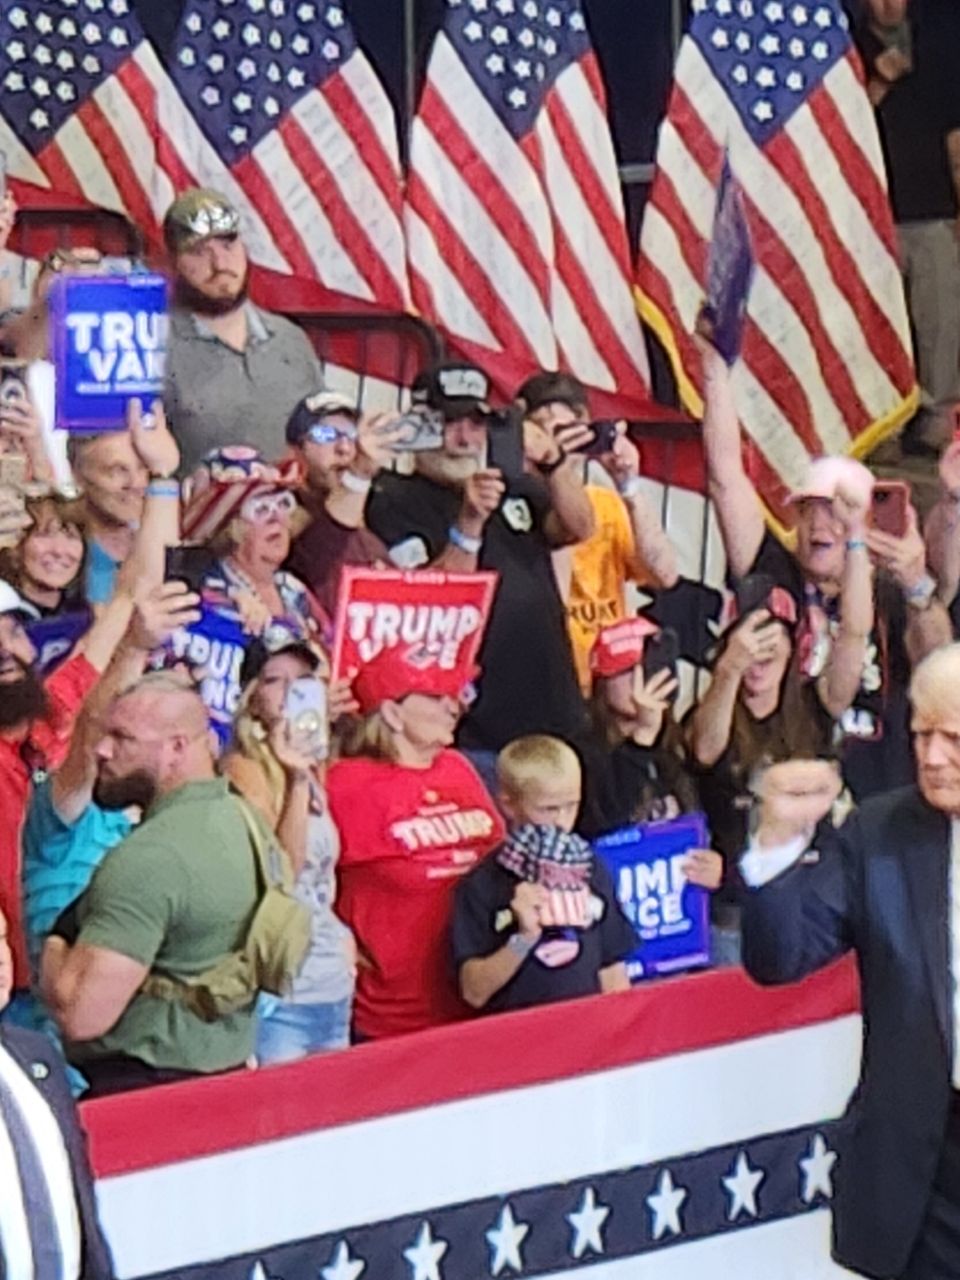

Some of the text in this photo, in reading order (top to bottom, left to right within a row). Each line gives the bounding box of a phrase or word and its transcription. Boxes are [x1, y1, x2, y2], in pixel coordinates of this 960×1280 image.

[66, 310, 168, 354] TRU
[347, 602, 481, 649] TRUMP
[391, 808, 494, 852] TRUMP
